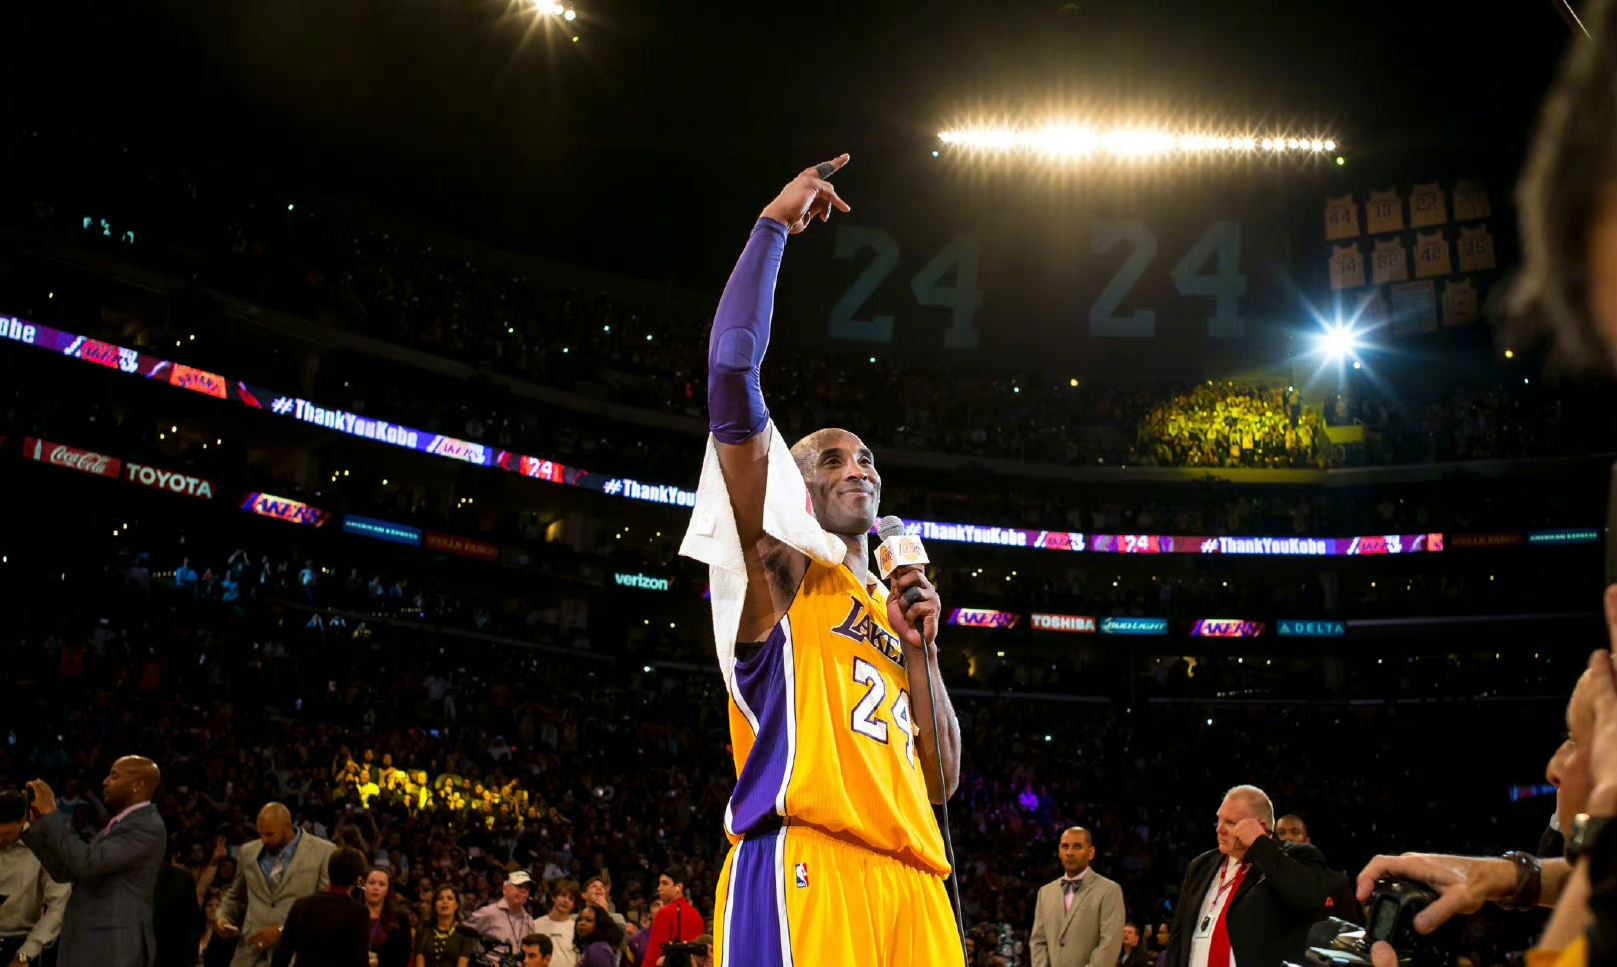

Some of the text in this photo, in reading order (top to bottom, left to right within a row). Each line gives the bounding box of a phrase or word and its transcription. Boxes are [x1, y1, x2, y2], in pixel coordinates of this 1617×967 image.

[829, 224, 984, 349] 24
[1089, 220, 1247, 337] 24
[272, 396, 418, 449] #ThankYouKobe
[126, 463, 212, 499] TOYOTA
[528, 456, 553, 481] 24
[904, 521, 1027, 547] #ThankYouKobe
[1125, 535, 1148, 553] 24
[1200, 536, 1326, 555] #ThankYouKobe
[615, 573, 668, 591] verizon
[1032, 615, 1094, 631] TOSHIBA
[1295, 622, 1344, 634] DELTA
[851, 655, 915, 769] 24
